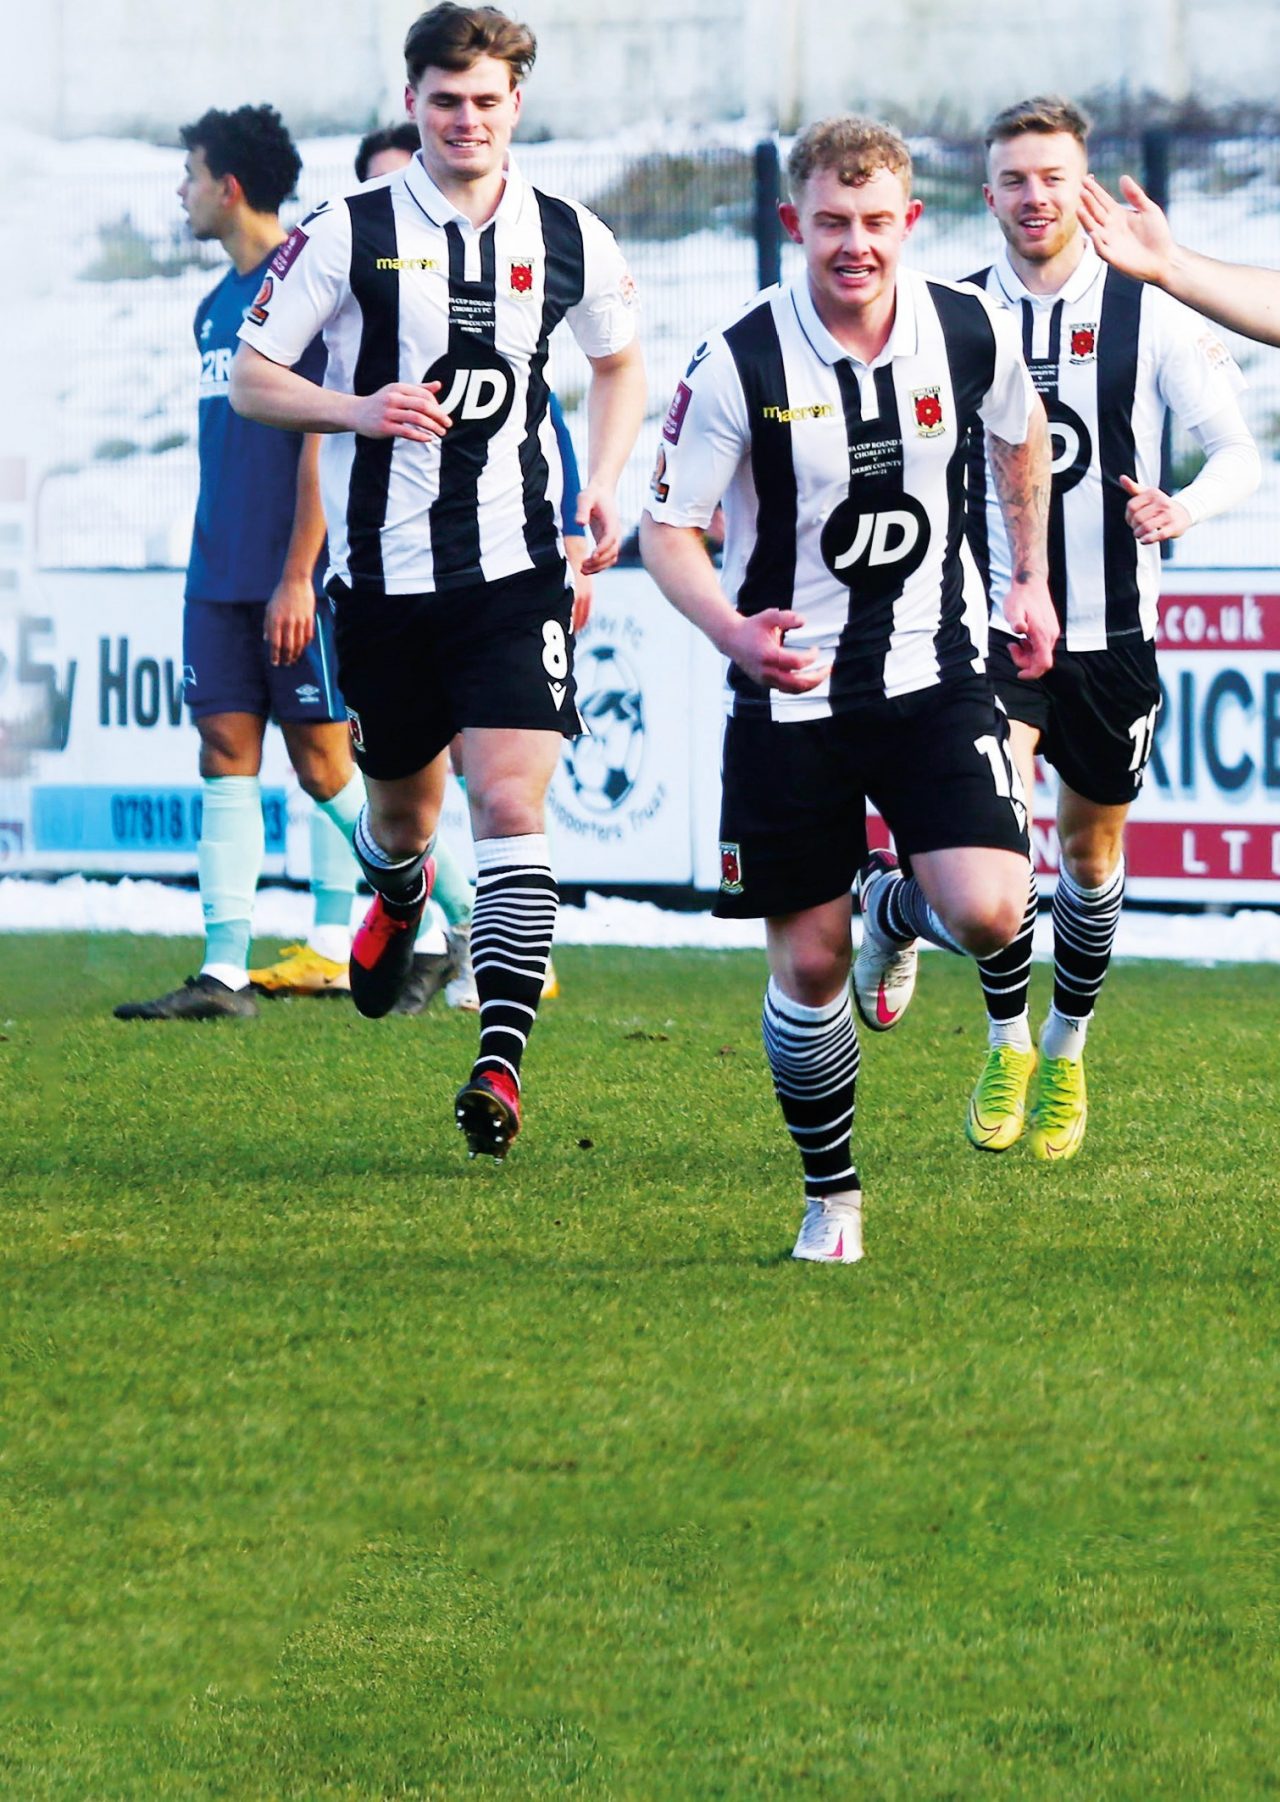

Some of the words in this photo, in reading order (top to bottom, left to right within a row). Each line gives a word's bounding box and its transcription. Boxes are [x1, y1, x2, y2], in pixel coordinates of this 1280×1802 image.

[440, 369, 508, 420] JD
[763, 402, 835, 423] macron
[1047, 422, 1080, 474] D
[834, 510, 919, 570] JD
[1154, 594, 1265, 643] .co.uk
[542, 620, 568, 680] 8
